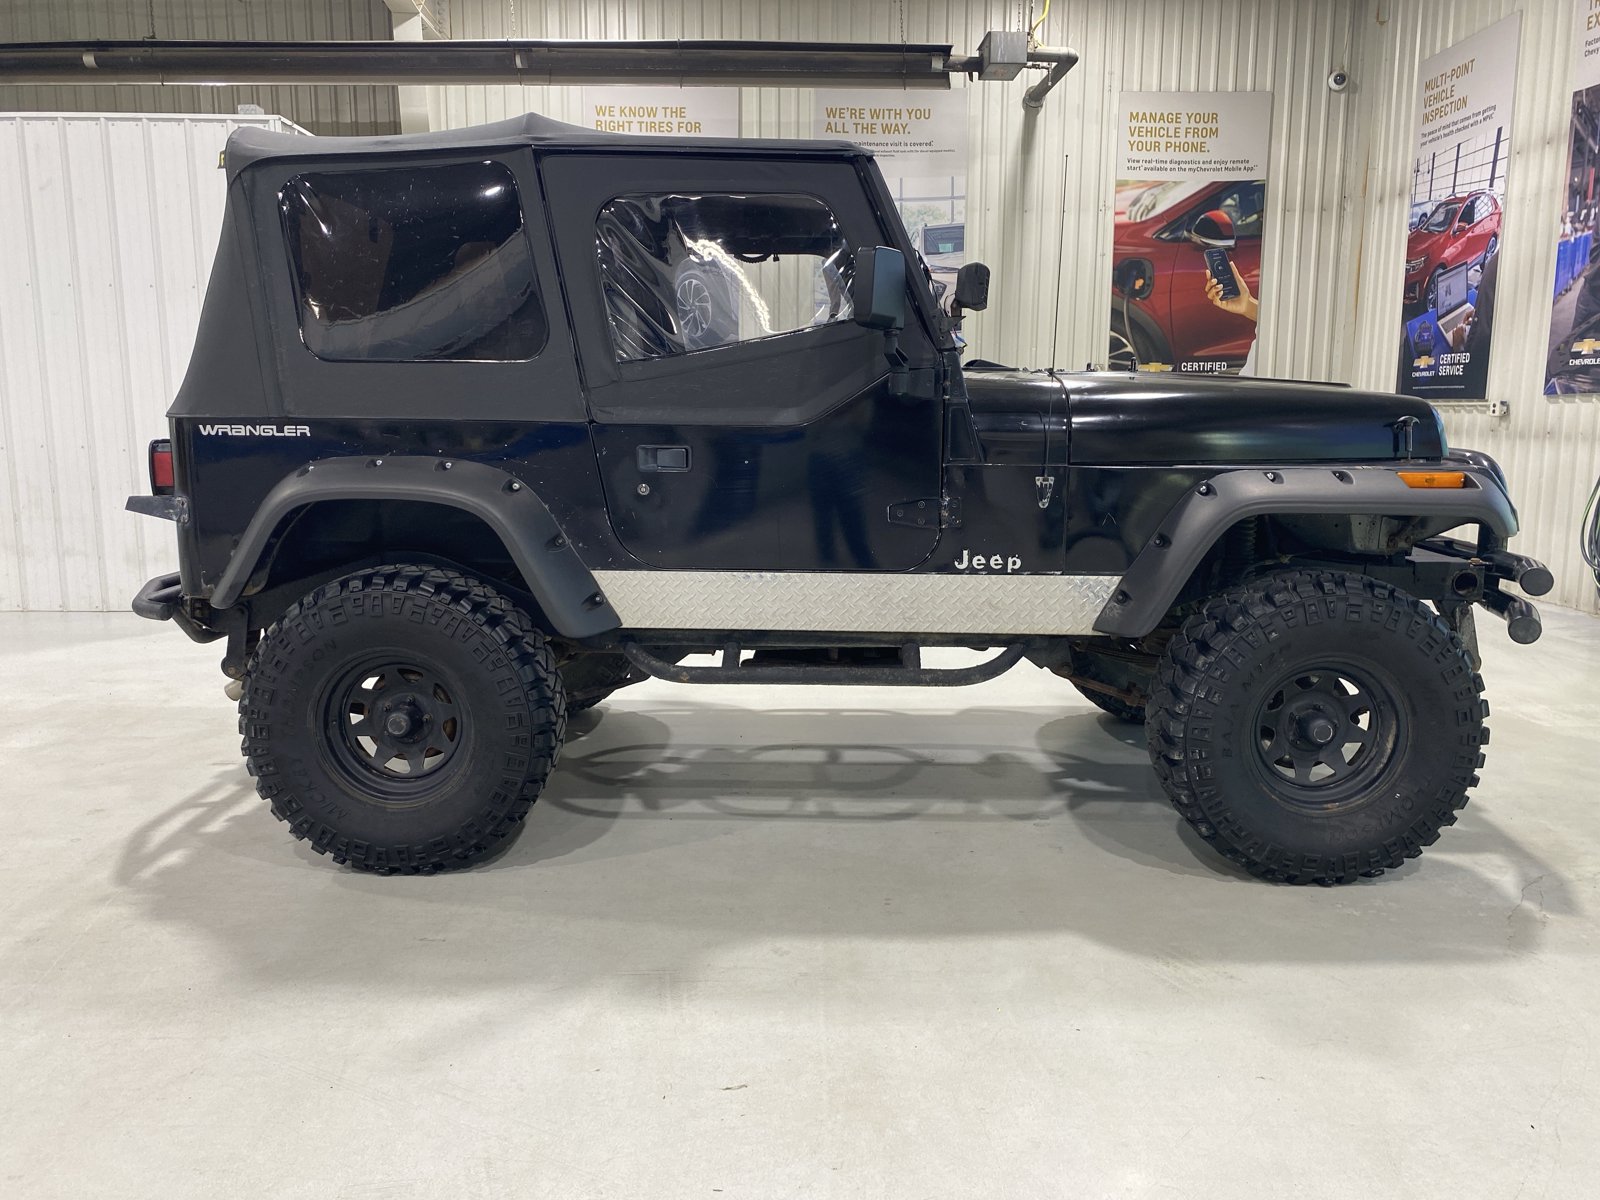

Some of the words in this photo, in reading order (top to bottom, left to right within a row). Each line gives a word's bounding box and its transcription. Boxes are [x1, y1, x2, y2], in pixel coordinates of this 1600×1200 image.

[1425, 58, 1475, 93] MULTI-POINT
[1423, 84, 1455, 109] VEHICLE
[595, 105, 615, 117] WE
[620, 105, 658, 118] KNOW
[662, 107, 686, 118] THE
[825, 107, 866, 119] WE'RE
[870, 108, 902, 120] WITH
[906, 108, 931, 120] YOU
[1422, 95, 1468, 126] INSPECTION
[1482, 104, 1496, 116] getting
[1129, 112, 1182, 124] MANAGE
[1186, 112, 1218, 124] YOUR
[595, 120, 633, 132] RIGHT
[637, 121, 673, 133] TIRES
[677, 121, 702, 133] FOR
[825, 122, 849, 134] ALL
[853, 122, 877, 134] THE
[881, 123, 911, 135] WAY.
[1129, 126, 1181, 138] VEHICLE
[1185, 127, 1219, 138] FROM
[1128, 140, 1161, 152] YOUR
[1165, 141, 1210, 153] PHONE.
[1440, 353, 1470, 364] CERTIFIED
[1181, 361, 1227, 371] CERTIFIED
[1439, 365, 1464, 376] SERVICE
[198, 424, 311, 437] WRANGLER
[954, 549, 1021, 573] Jeep
